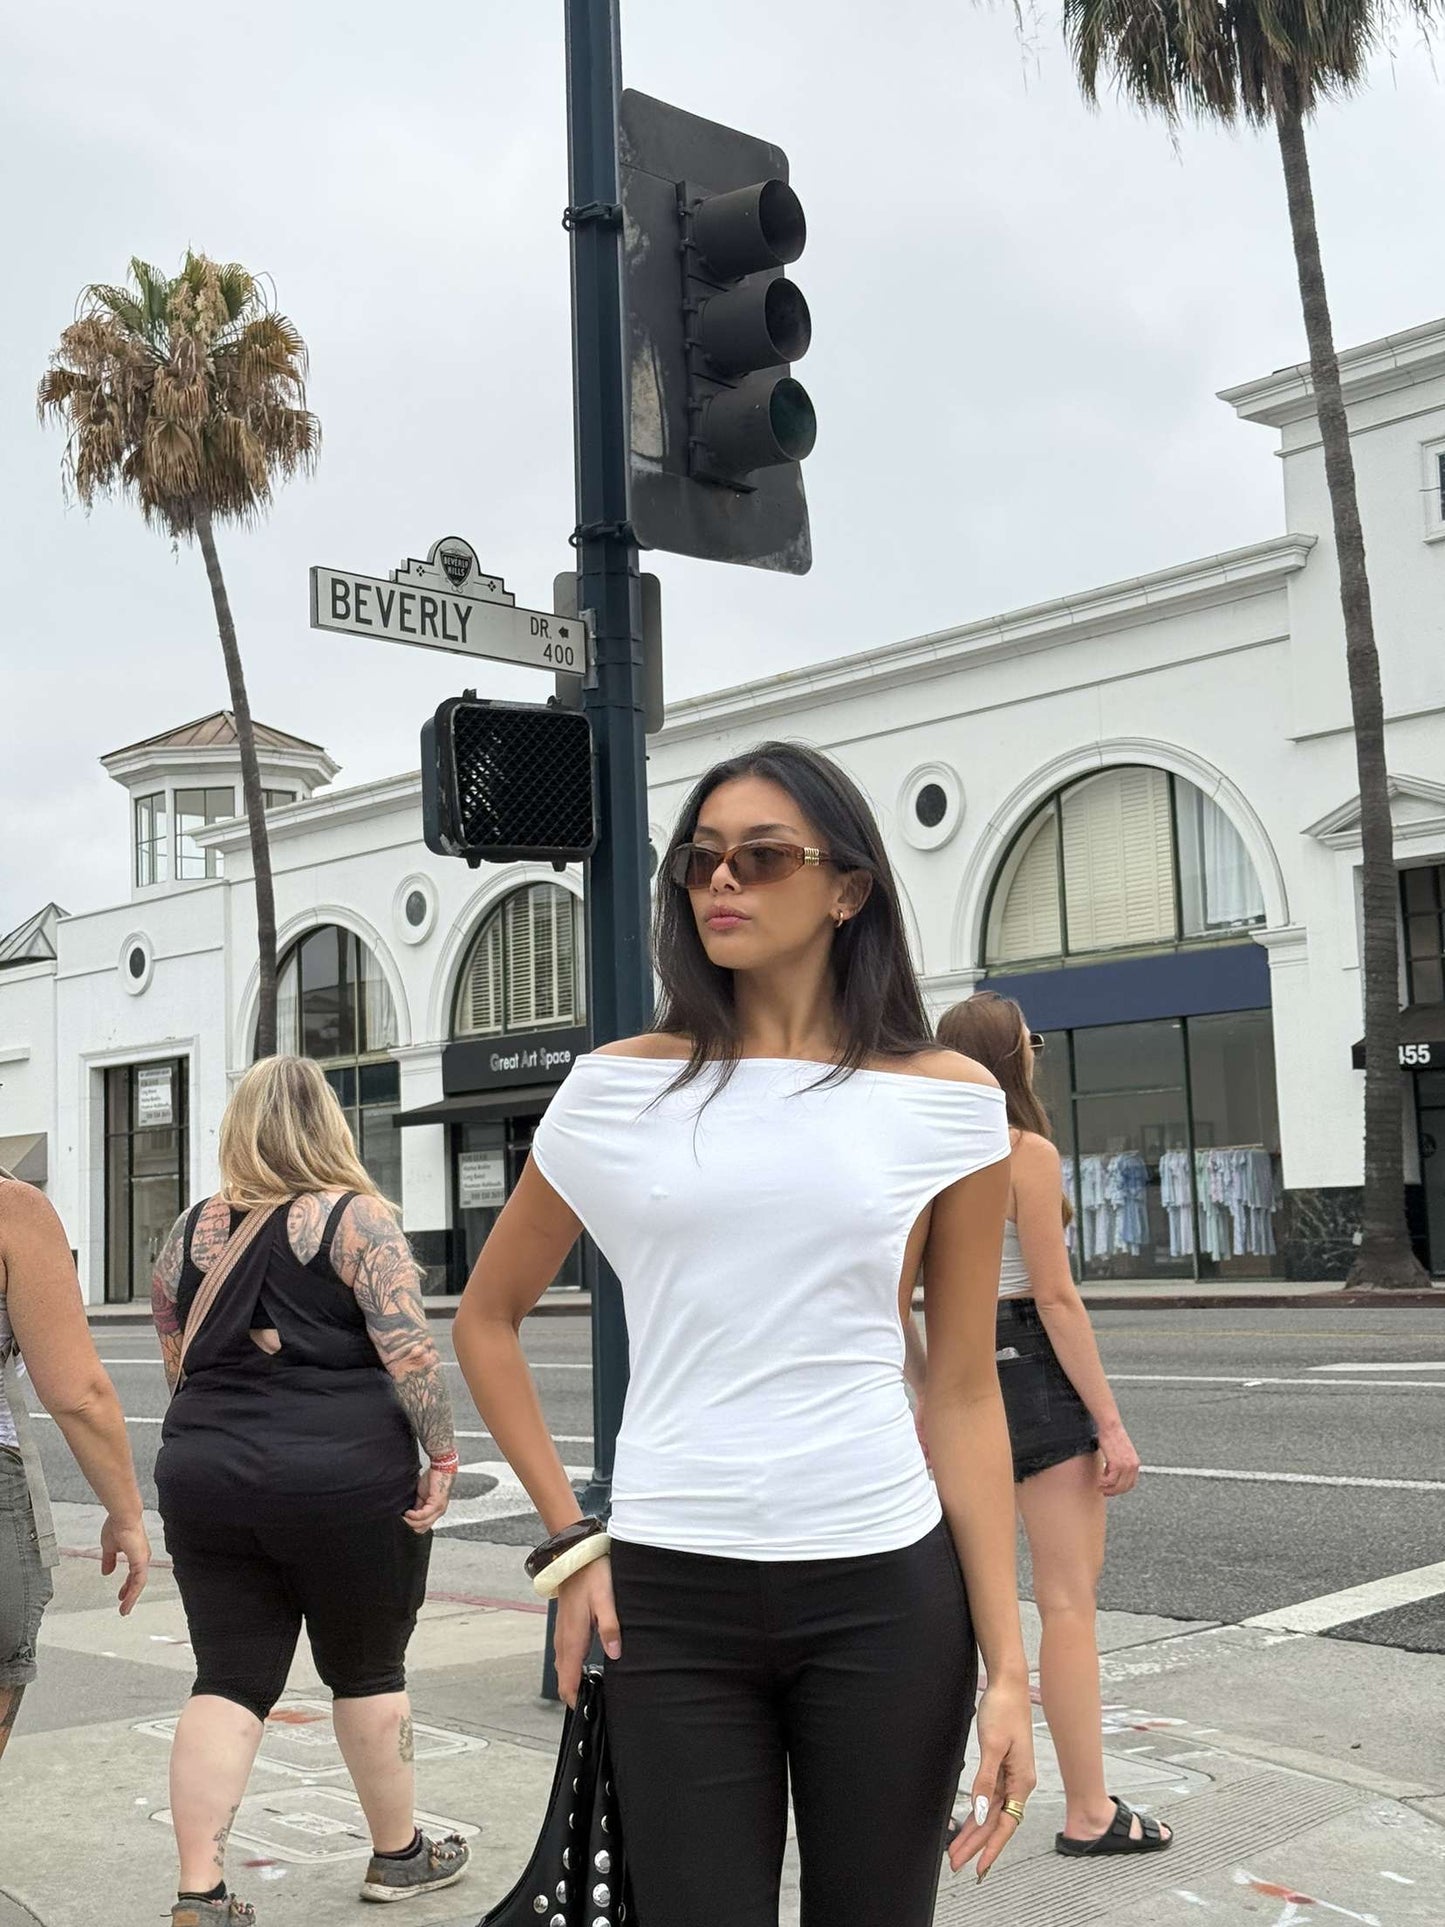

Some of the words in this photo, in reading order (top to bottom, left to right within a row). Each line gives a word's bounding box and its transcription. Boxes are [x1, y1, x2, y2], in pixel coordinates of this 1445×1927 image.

[443, 556, 469, 569] BEVERLY
[447, 566, 466, 577] HILLS
[331, 577, 473, 643] BEVERLY
[530, 616, 552, 640] DR.
[543, 643, 574, 666] 400
[490, 1053, 519, 1072] Great
[520, 1050, 537, 1068] Art
[540, 1047, 571, 1070] Space
